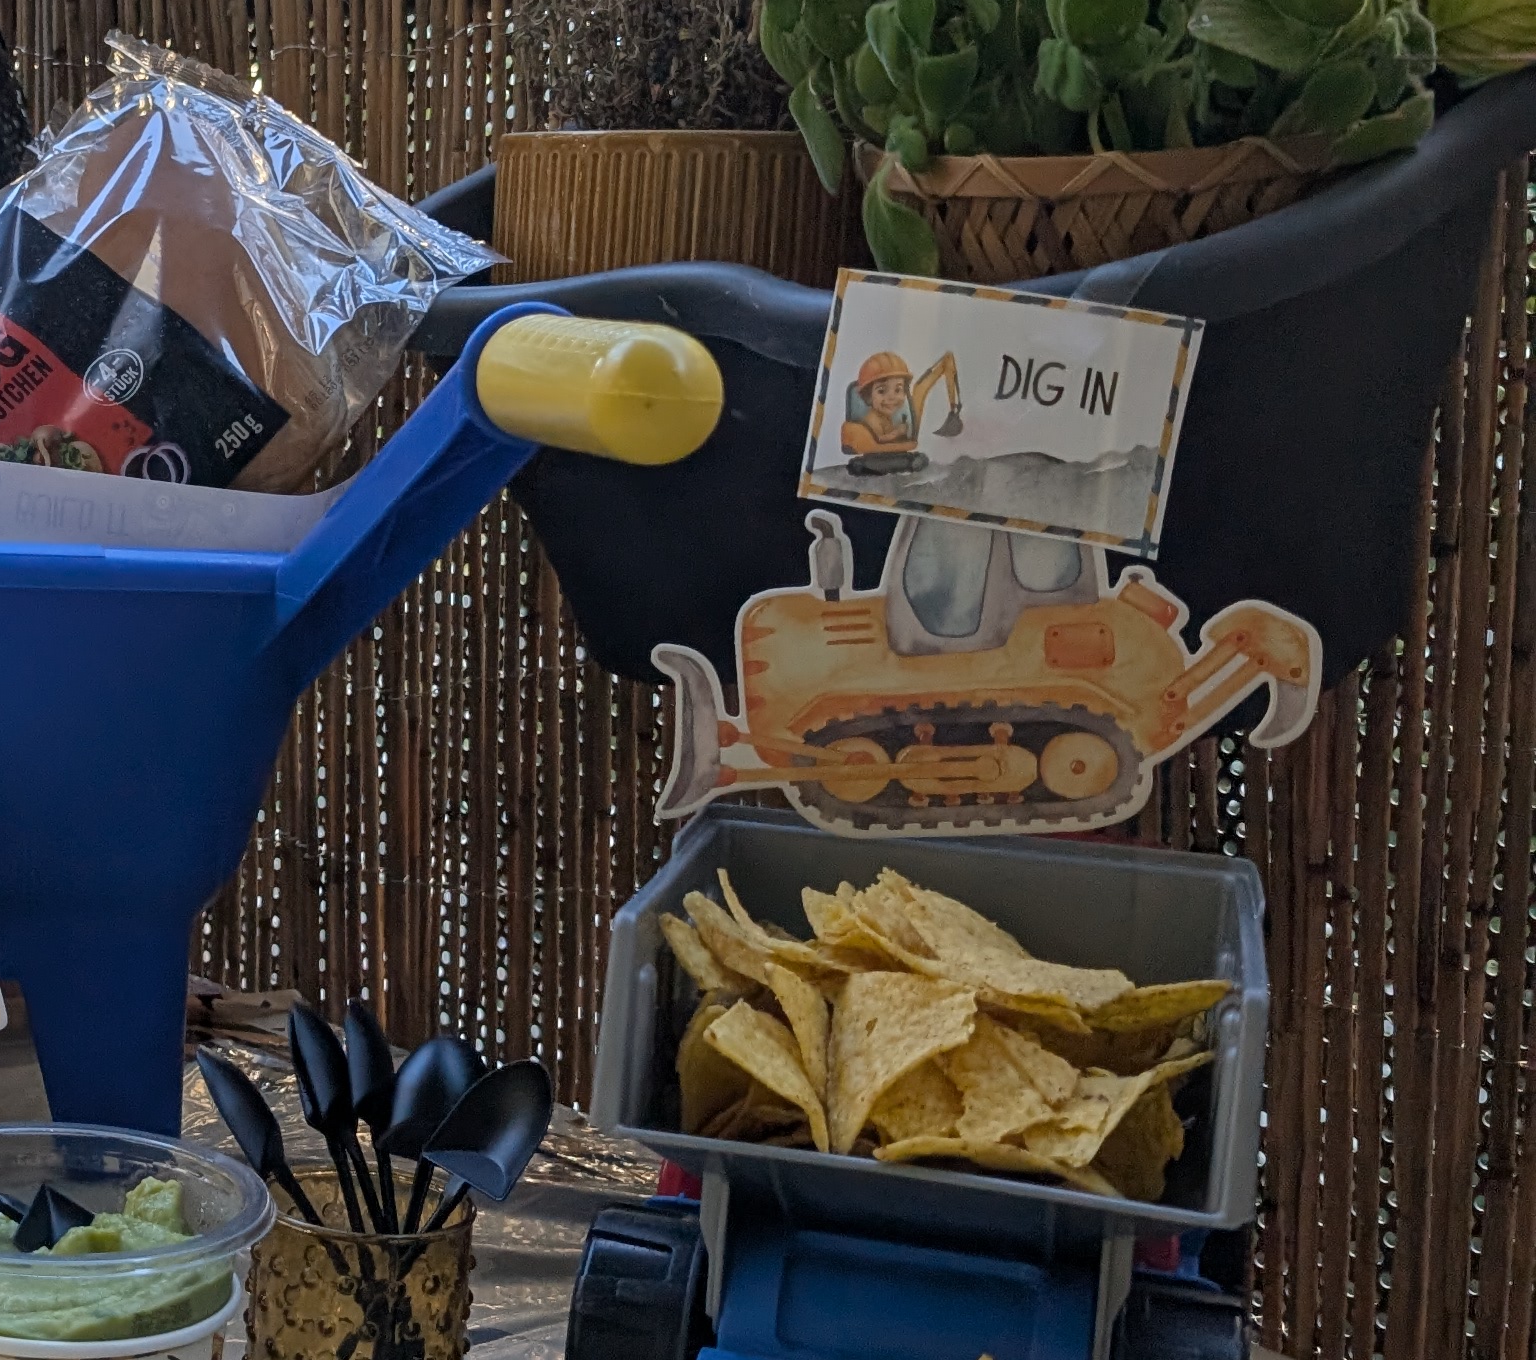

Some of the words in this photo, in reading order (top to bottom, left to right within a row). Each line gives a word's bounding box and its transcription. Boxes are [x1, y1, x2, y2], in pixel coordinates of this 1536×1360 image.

[103, 366, 139, 402] STÜCK
[993, 354, 1066, 406] DIG
[1079, 367, 1119, 416] IN
[215, 421, 249, 459] 250
[244, 413, 263, 434] g
